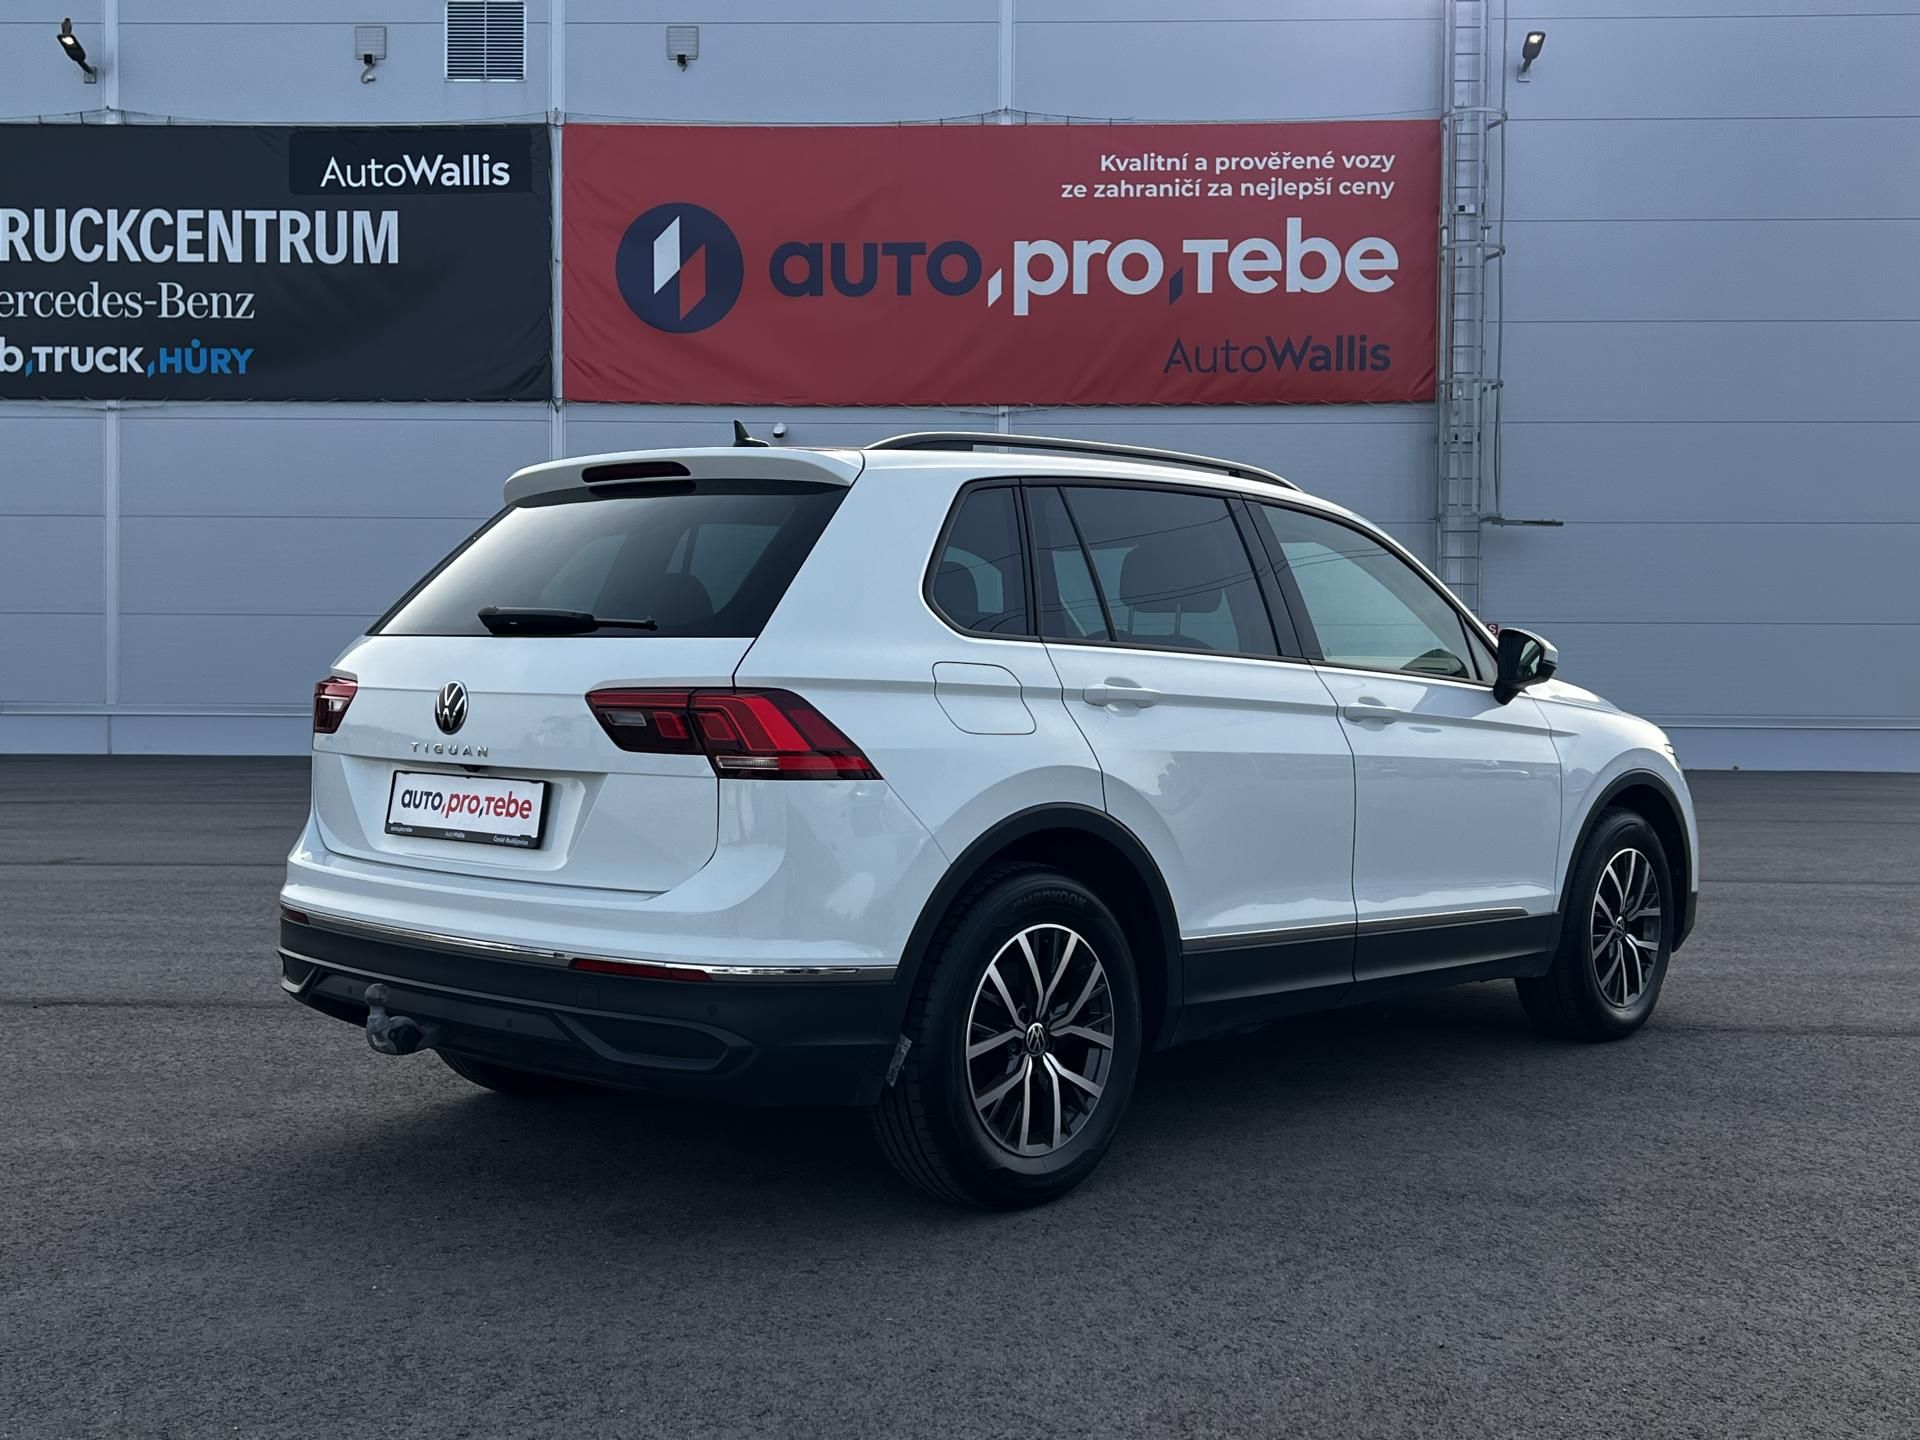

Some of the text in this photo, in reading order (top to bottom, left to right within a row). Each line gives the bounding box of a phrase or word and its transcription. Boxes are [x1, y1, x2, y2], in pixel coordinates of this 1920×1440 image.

[320, 153, 510, 187] AutoWallis
[1100, 151, 1396, 175] Kvalitní a prověřené vozy
[1061, 177, 1395, 200] ze zahraničí za nejlepší ceny
[0, 207, 399, 264] RUCKCENTRUM
[1164, 335, 1391, 373] AutoWallis
[410, 741, 489, 758] TIGUAN
